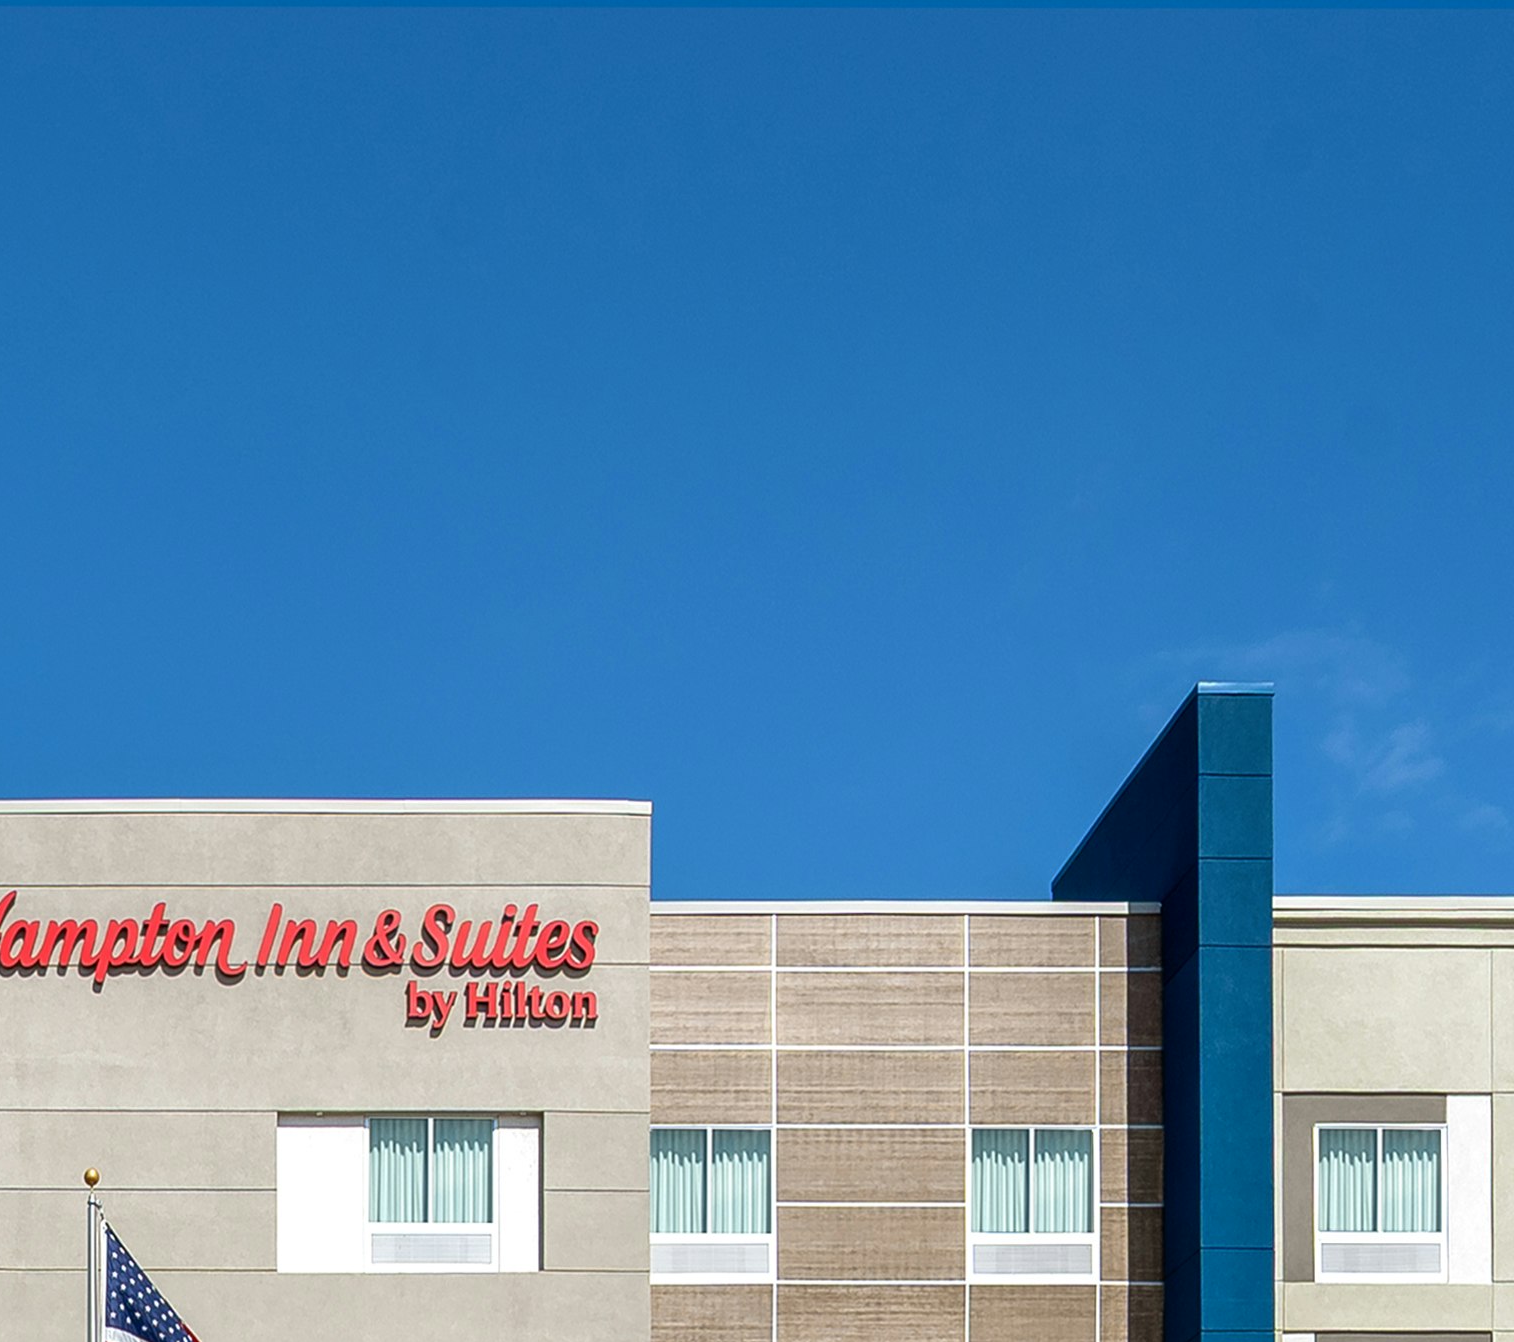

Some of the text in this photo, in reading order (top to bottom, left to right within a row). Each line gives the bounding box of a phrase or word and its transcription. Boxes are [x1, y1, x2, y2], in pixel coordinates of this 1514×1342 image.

[256, 903, 358, 969] Inn
[411, 903, 599, 970] Suites
[407, 980, 598, 1030] by Hilton
